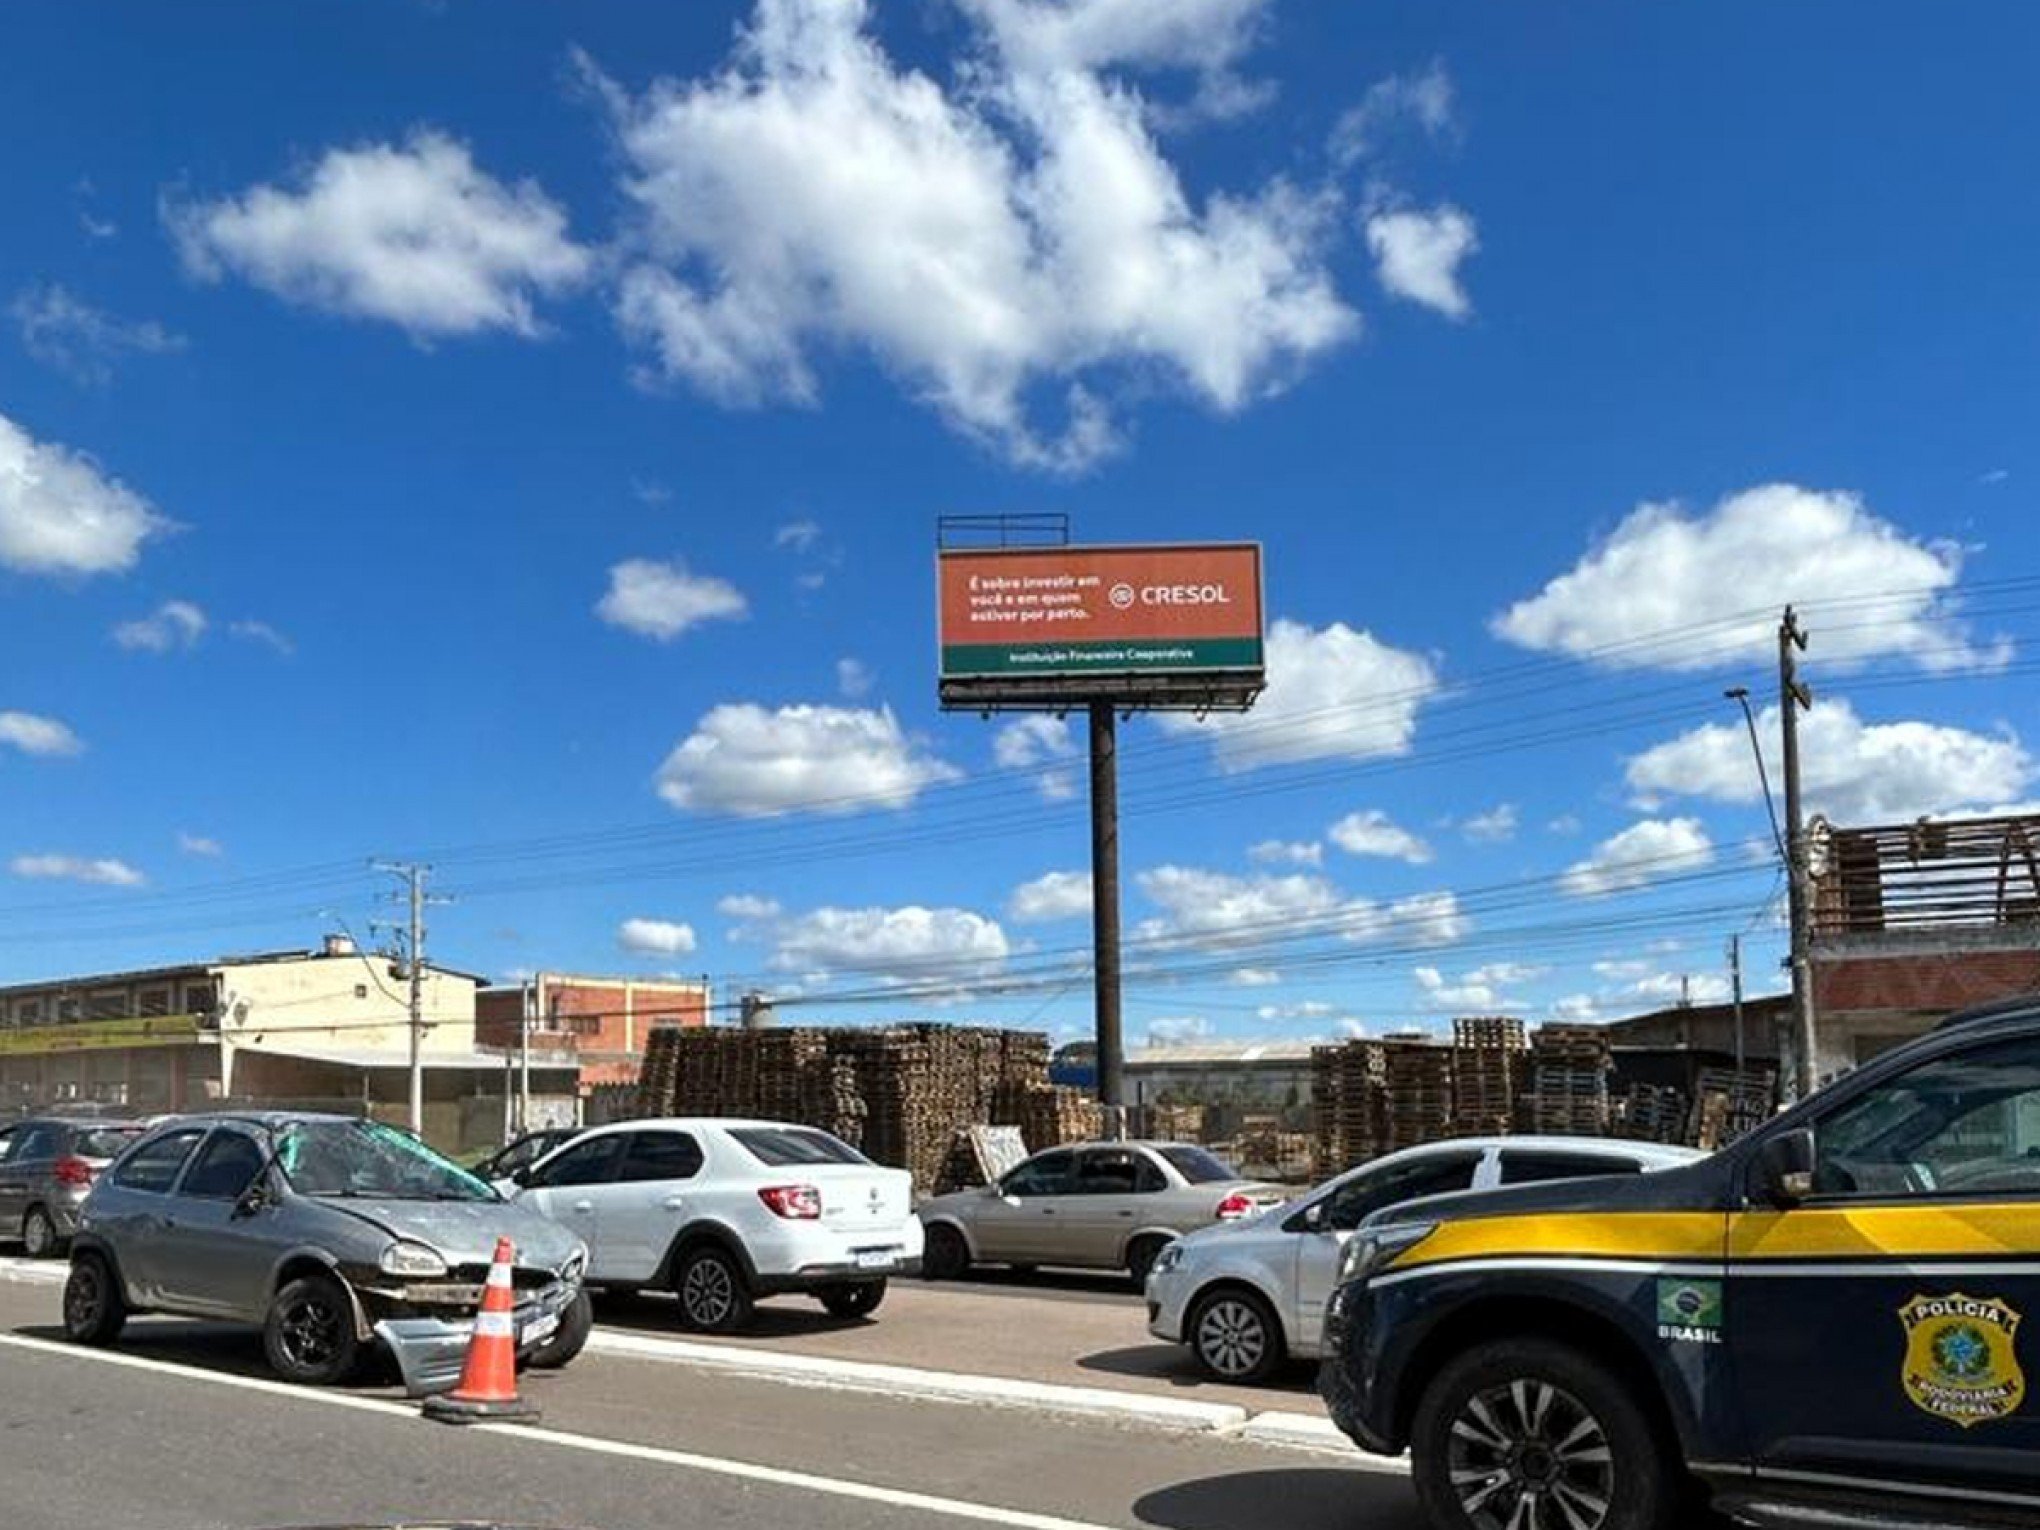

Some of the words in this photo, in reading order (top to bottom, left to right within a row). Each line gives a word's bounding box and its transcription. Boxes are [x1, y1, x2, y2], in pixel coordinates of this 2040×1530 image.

[1017, 594, 1038, 605] em
[1140, 584, 1231, 605] CRESOL
[1021, 611, 1043, 624] por
[1658, 1325, 1722, 1343] BRASIL
